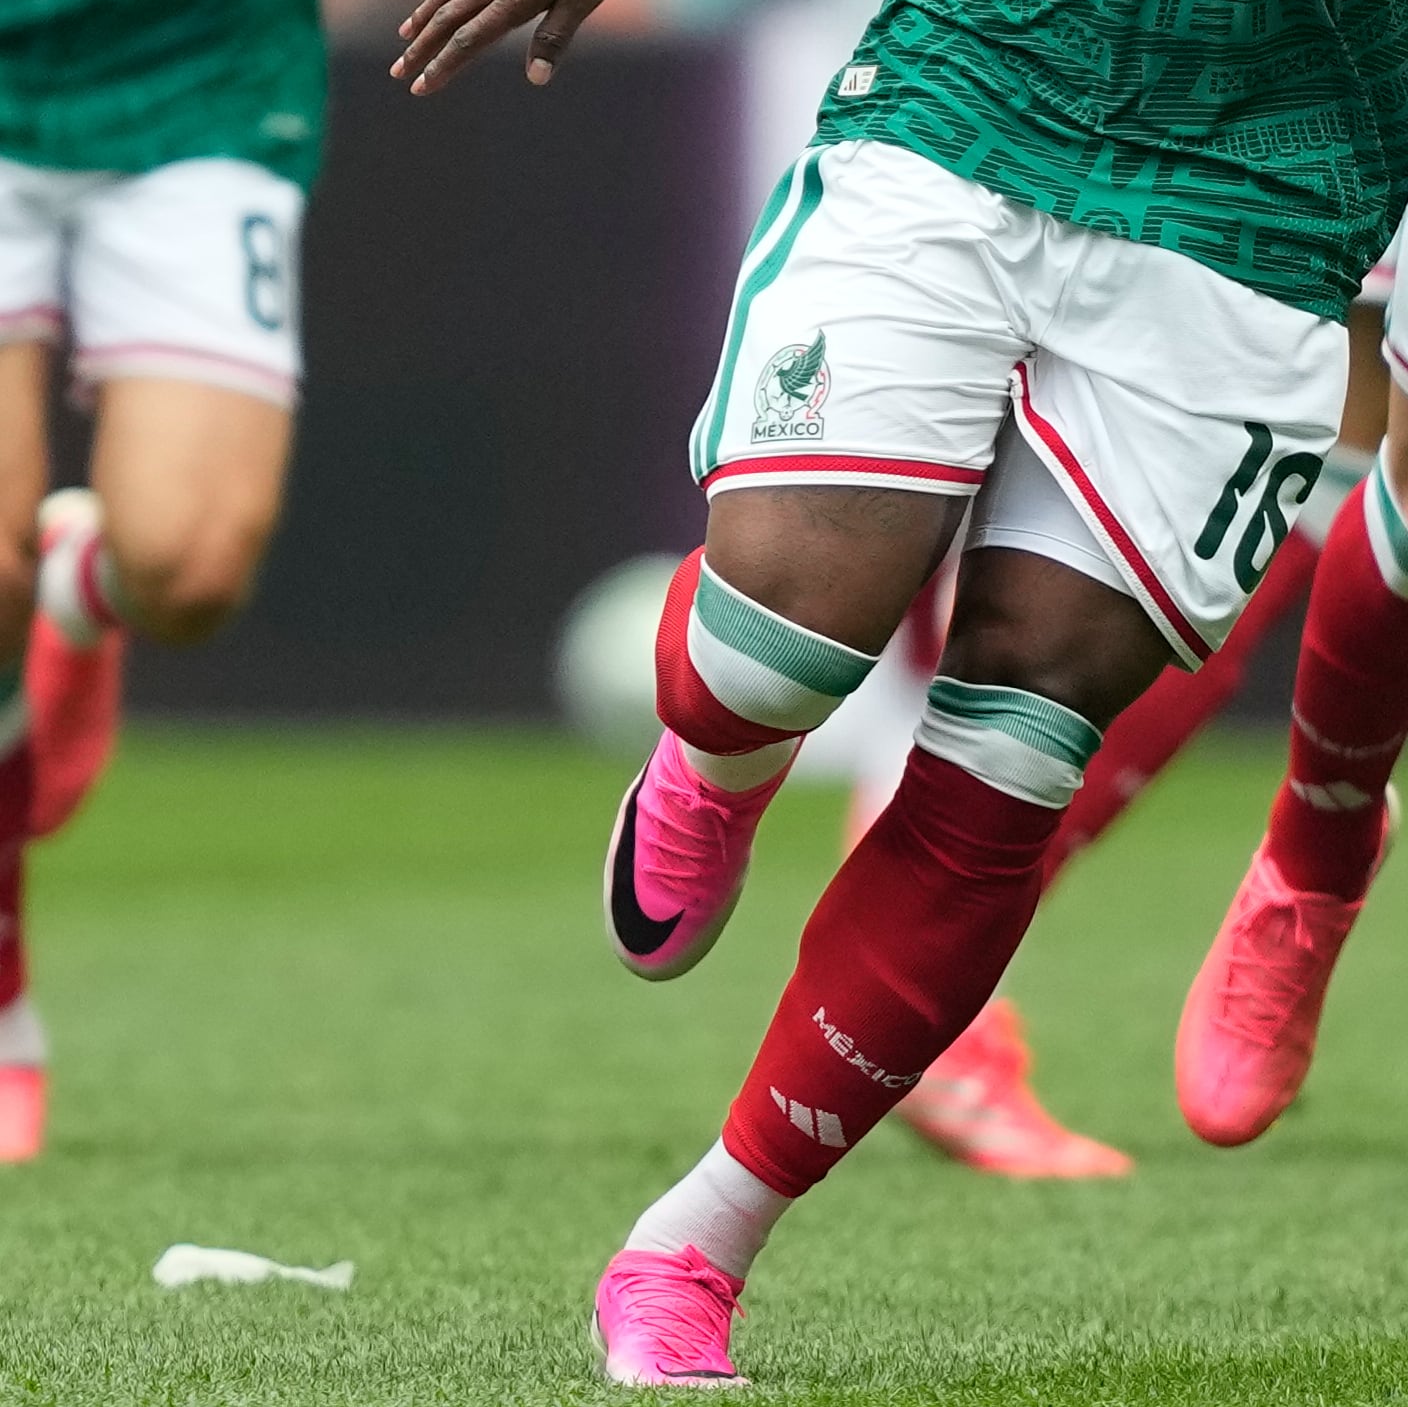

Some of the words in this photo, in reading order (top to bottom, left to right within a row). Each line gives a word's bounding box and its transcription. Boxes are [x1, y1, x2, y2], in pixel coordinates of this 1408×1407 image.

[754, 421, 820, 439] MÉXICO
[1194, 421, 1324, 594] 16
[812, 1005, 922, 1088] MÉXICO
